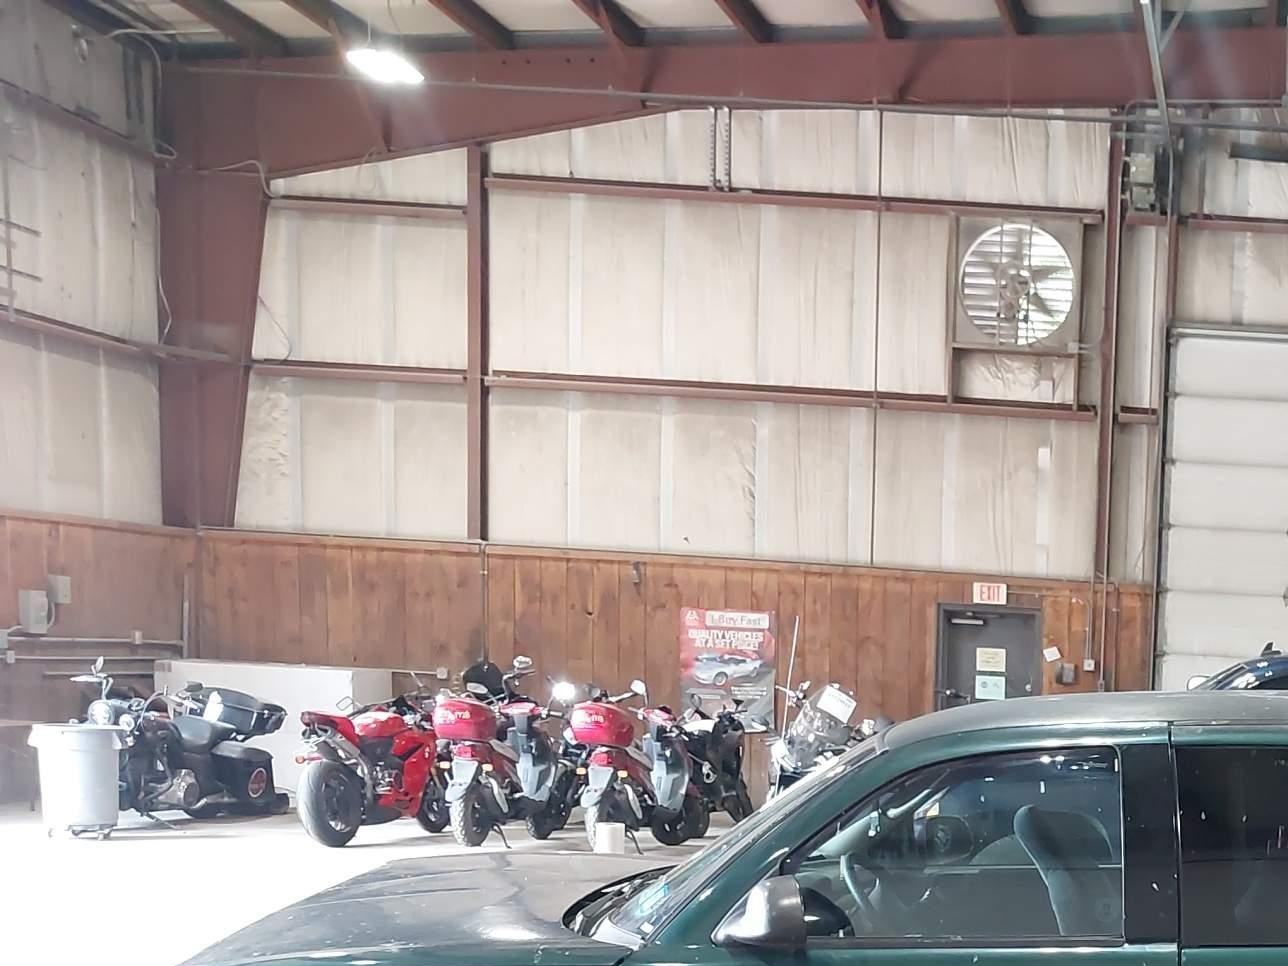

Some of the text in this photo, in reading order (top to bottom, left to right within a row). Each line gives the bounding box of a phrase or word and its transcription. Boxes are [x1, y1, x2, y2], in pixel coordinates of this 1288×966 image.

[980, 584, 1001, 602] EXIT
[740, 615, 761, 626] Fast
[688, 629, 764, 642] QUALITY VEHICLES
